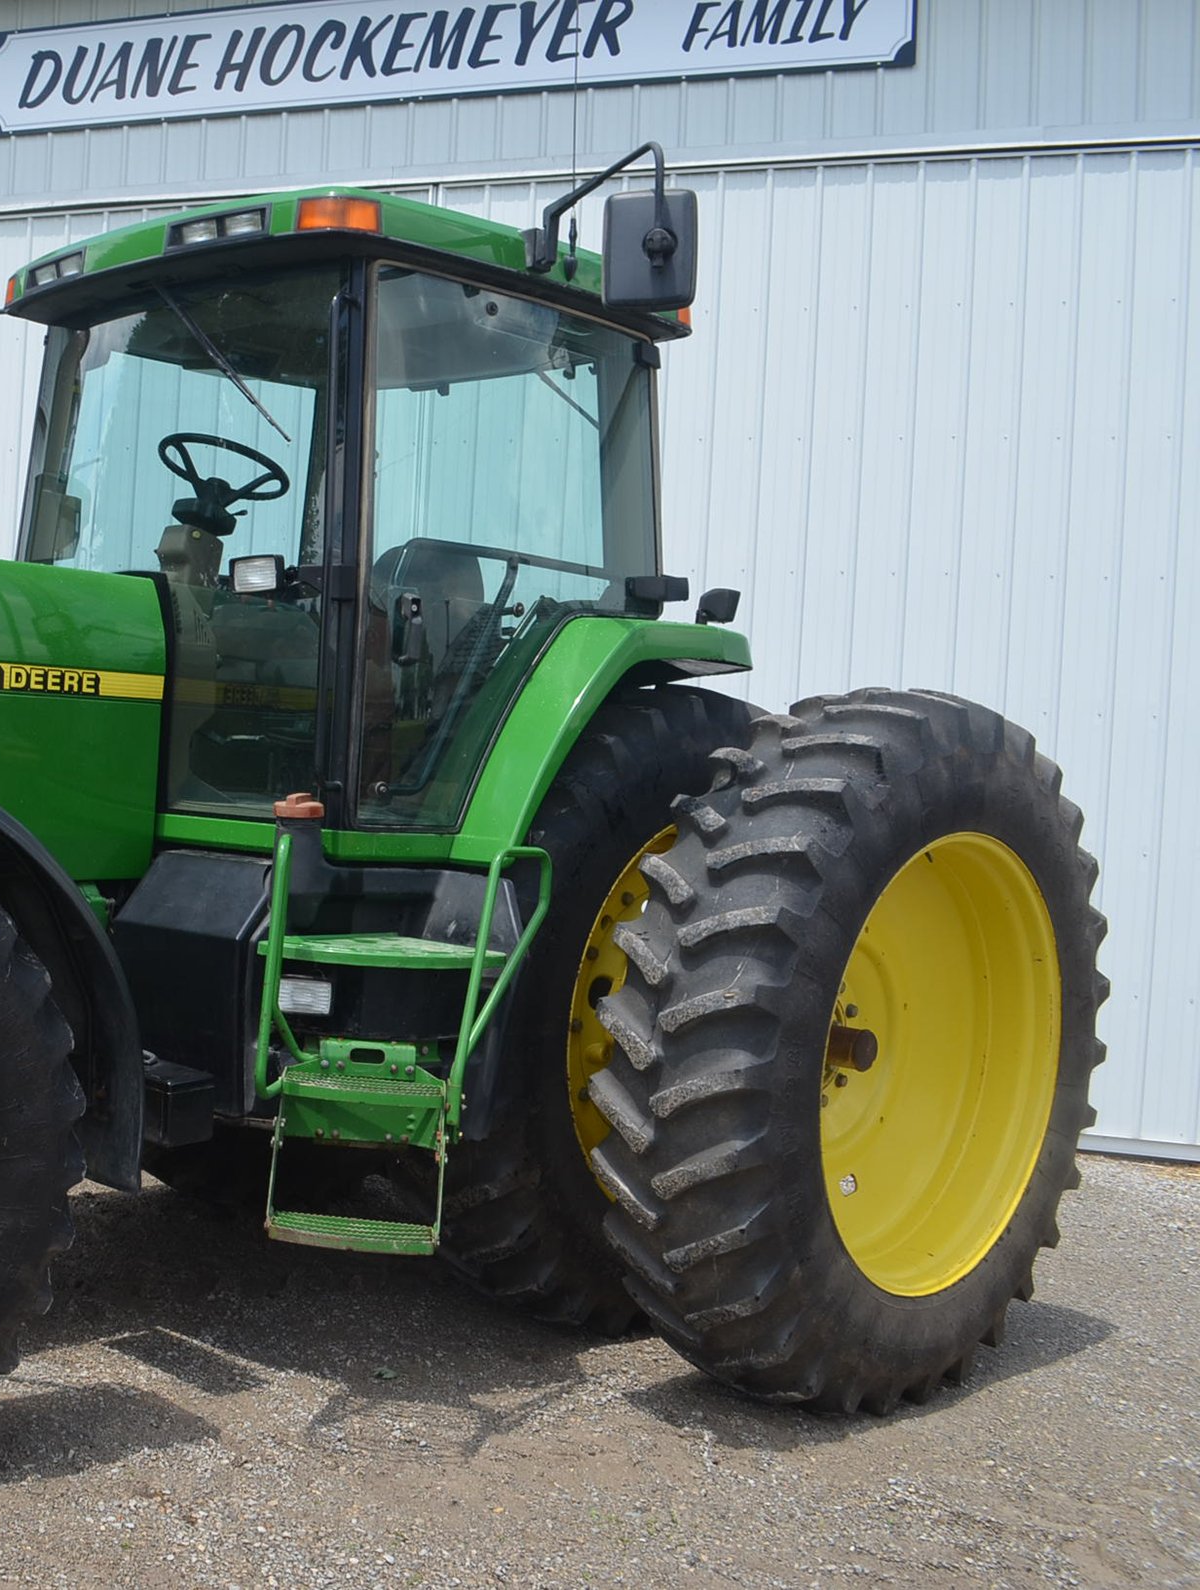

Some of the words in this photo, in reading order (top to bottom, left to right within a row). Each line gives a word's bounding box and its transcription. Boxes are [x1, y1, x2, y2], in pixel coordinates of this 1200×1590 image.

[18, 34, 212, 109] DUANE
[214, 0, 634, 92] HOCKEMEYER
[681, 0, 869, 52] FAMILY
[9, 666, 100, 696] DEERE
